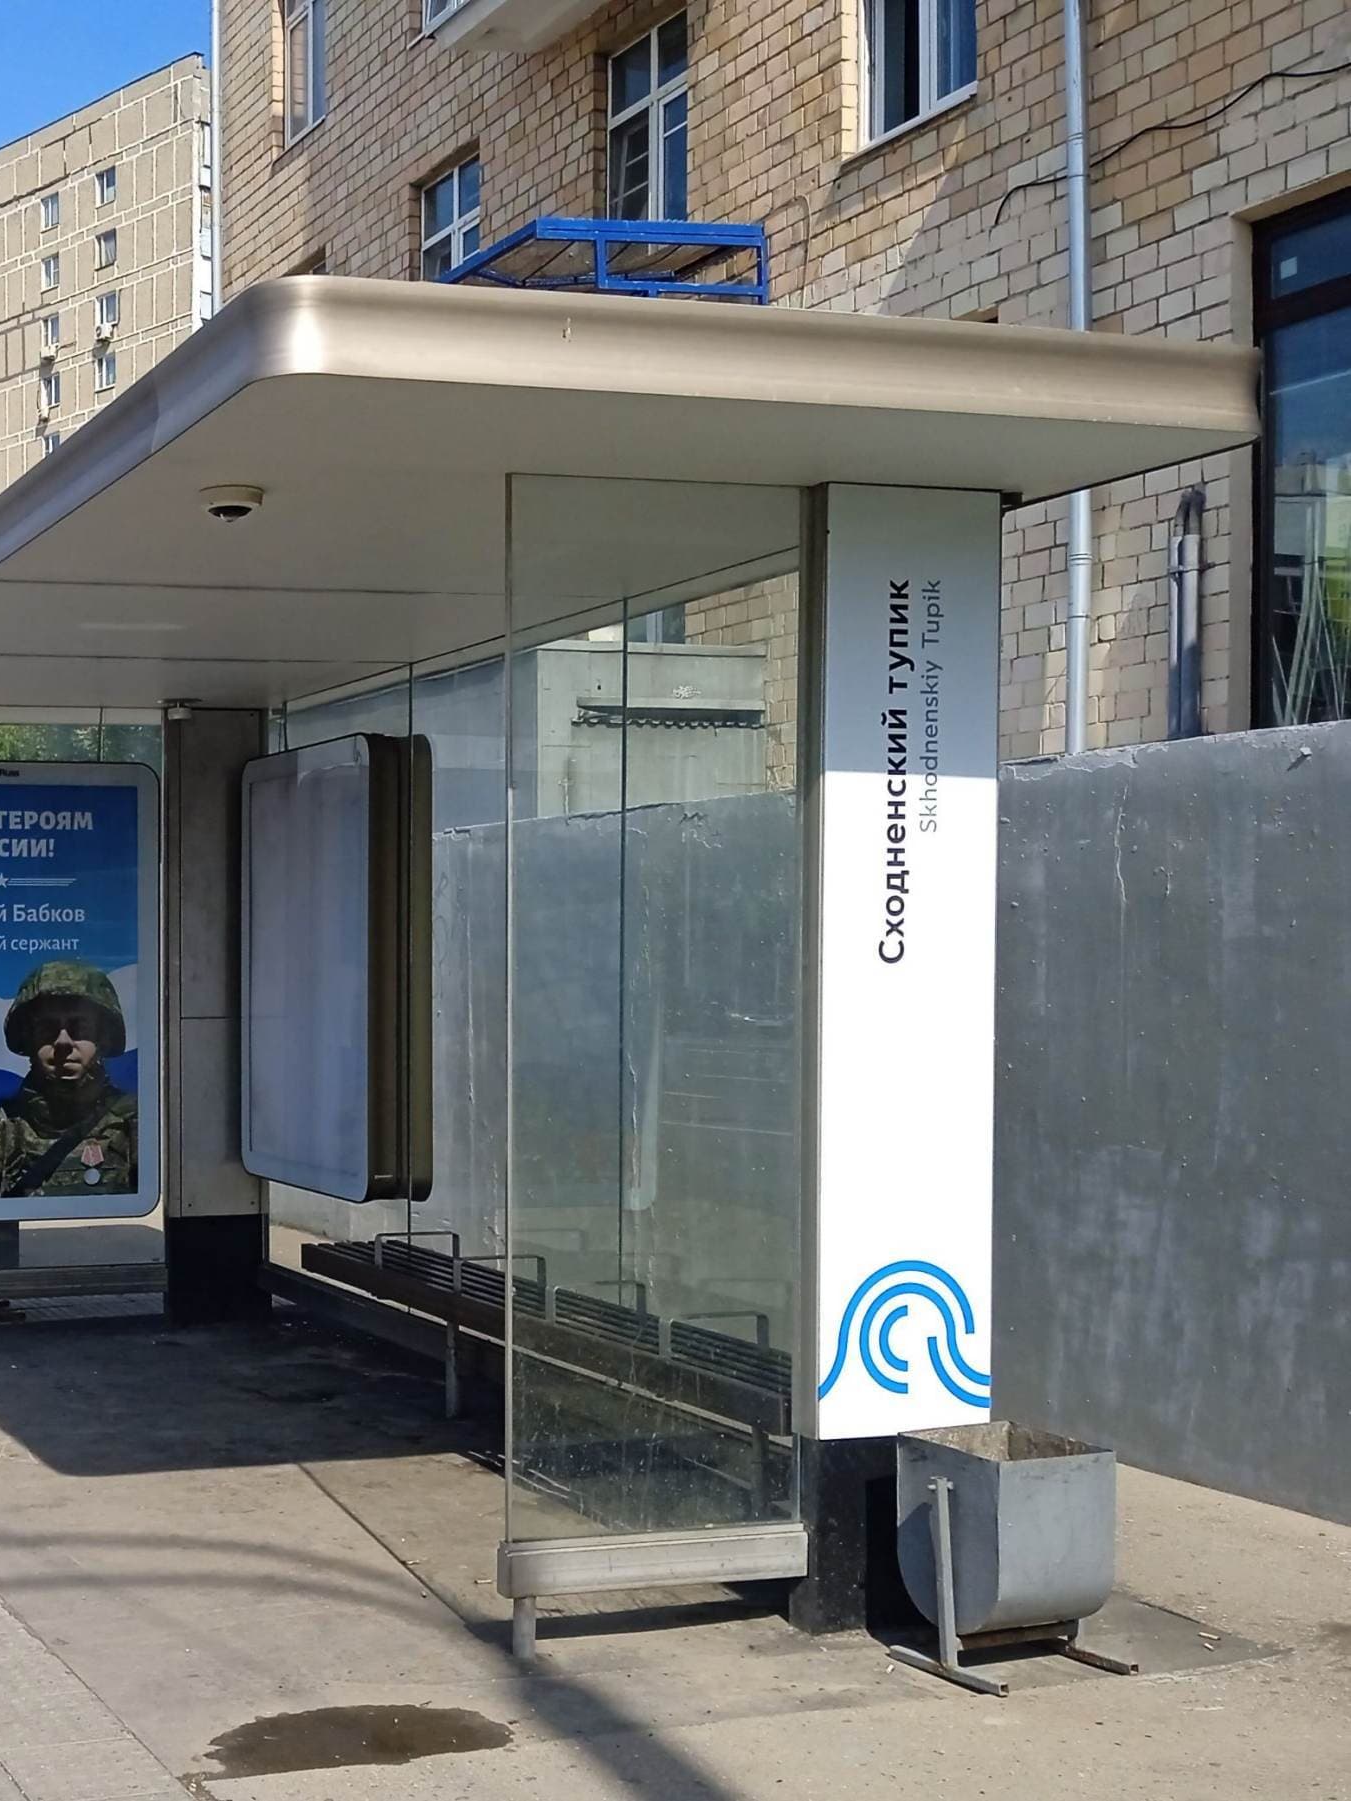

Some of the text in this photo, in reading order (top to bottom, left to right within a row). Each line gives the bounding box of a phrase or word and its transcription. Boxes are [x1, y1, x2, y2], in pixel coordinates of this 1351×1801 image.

[878, 579, 916, 964] Сходненский тупик
[919, 579, 945, 833] Skhodnenskiy Tupik
[10, 938, 80, 954] сержант
[13, 903, 86, 923] Бабков
